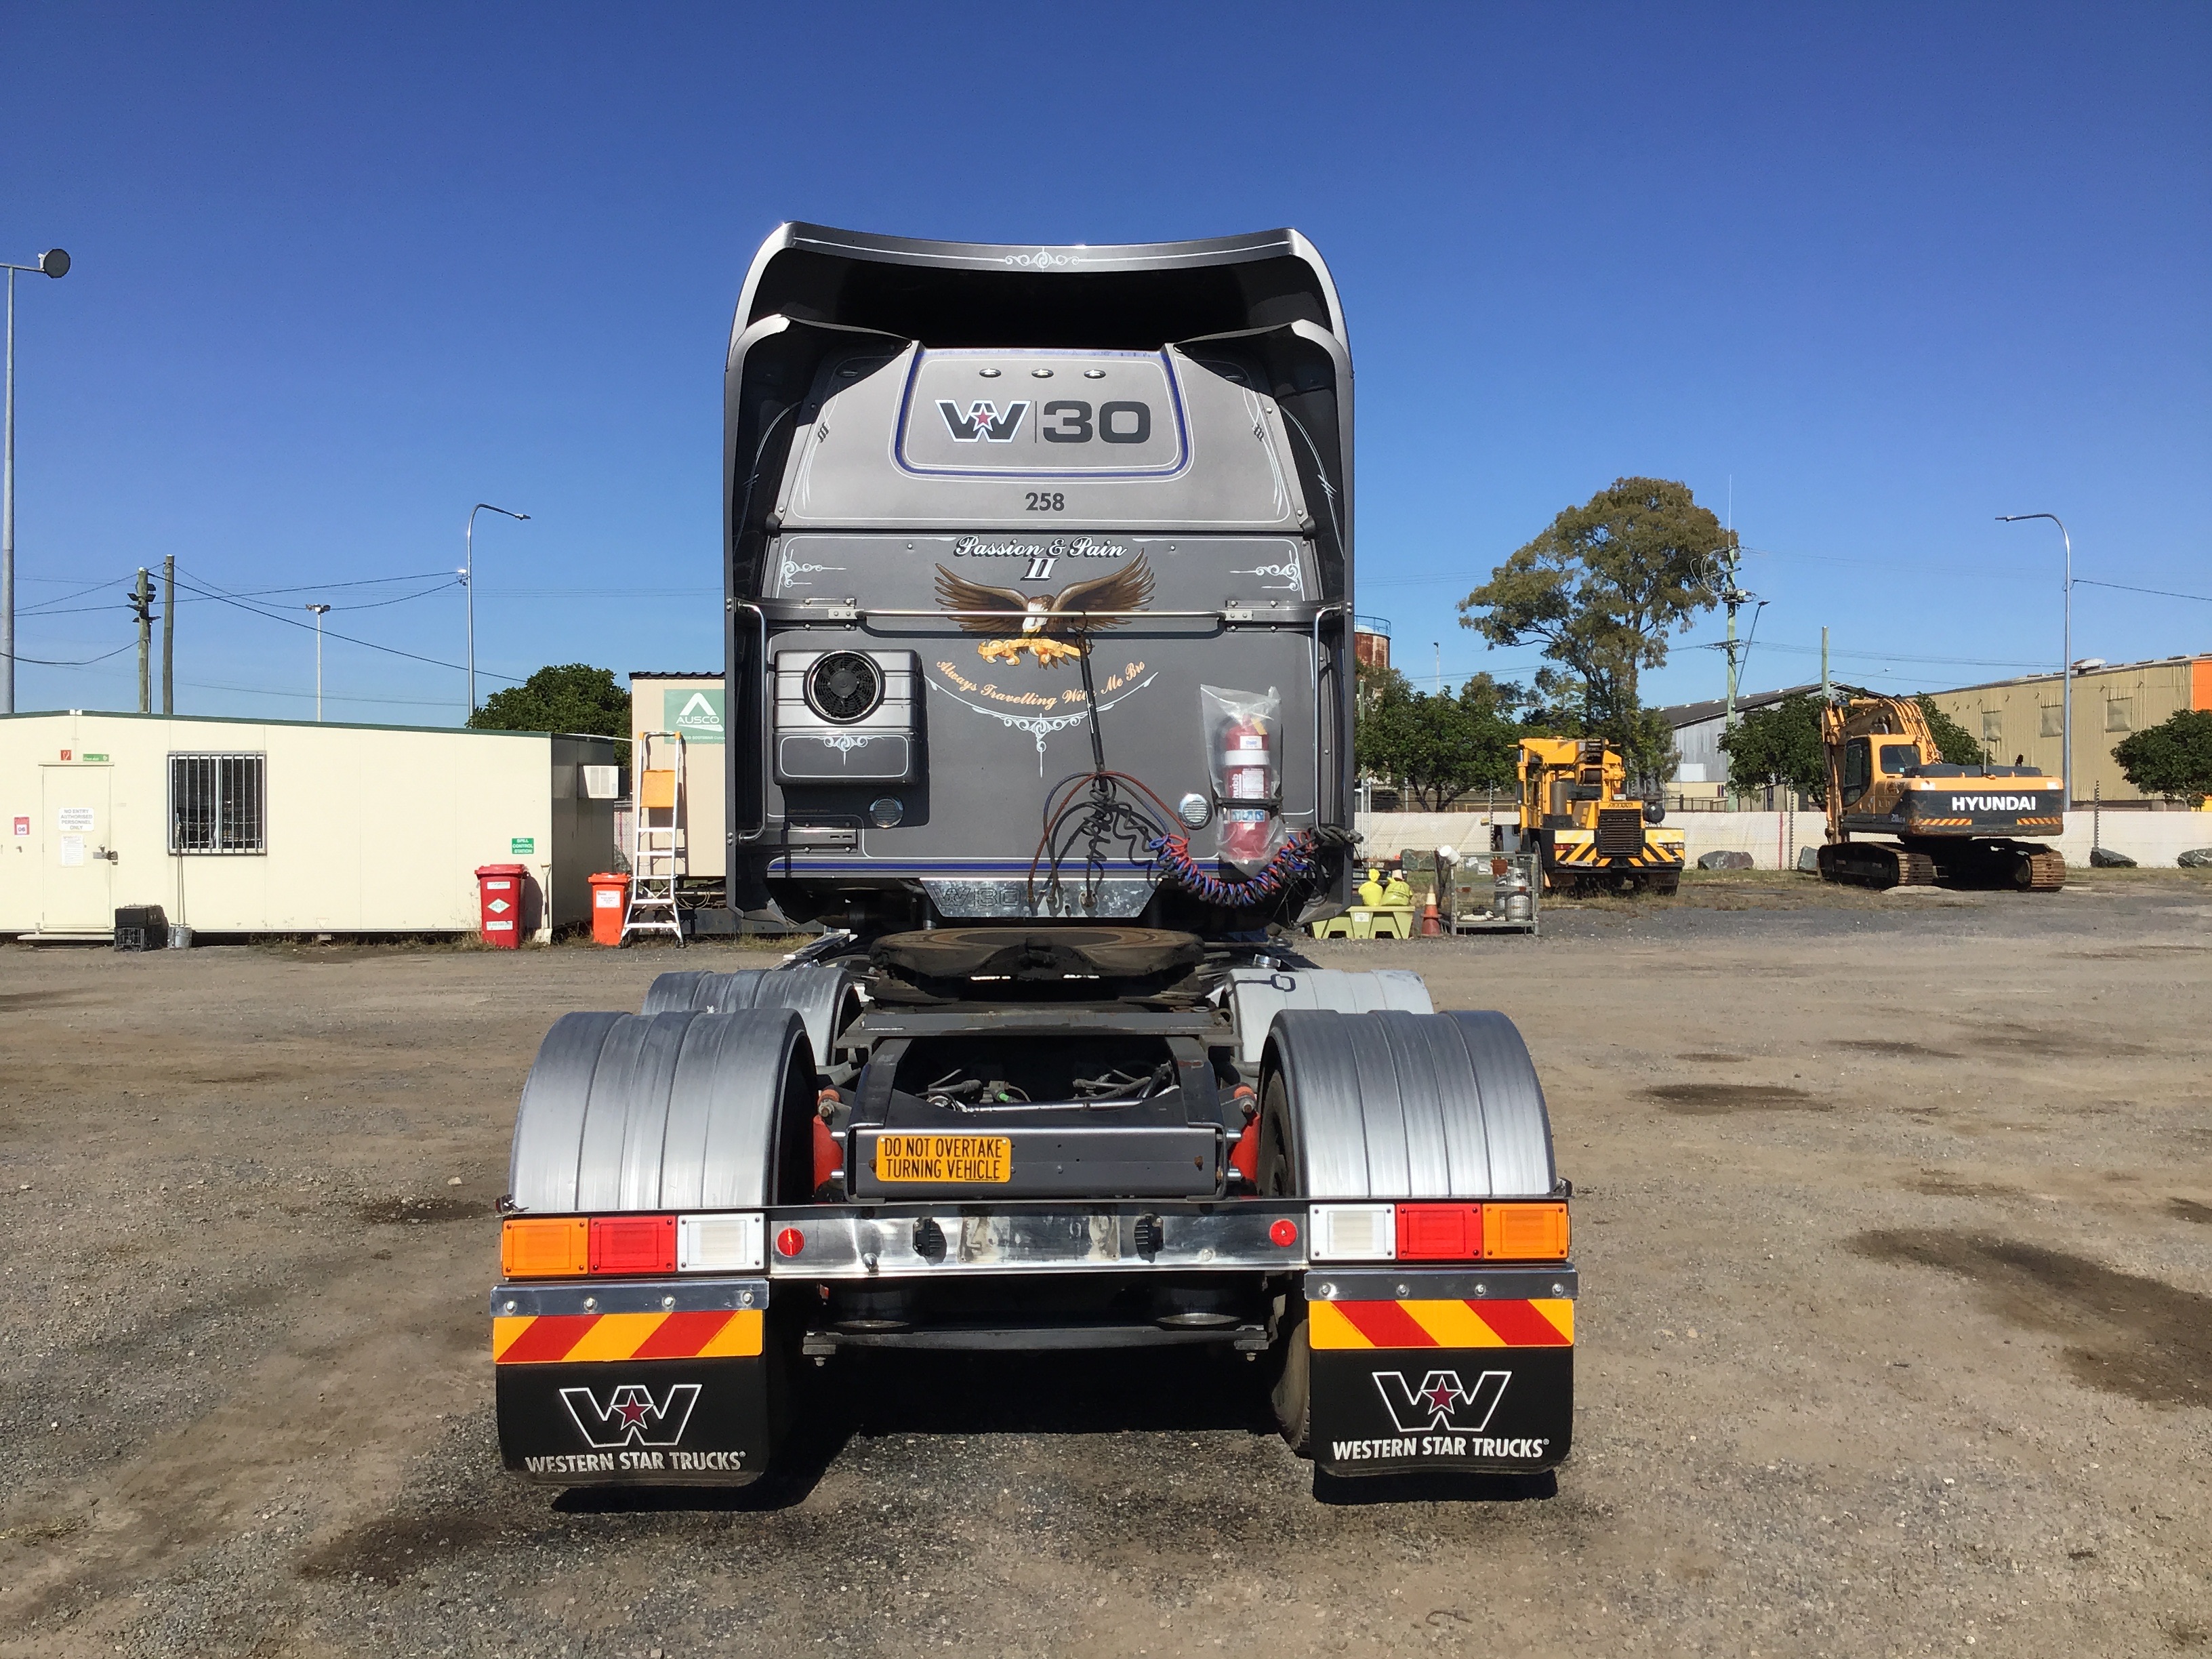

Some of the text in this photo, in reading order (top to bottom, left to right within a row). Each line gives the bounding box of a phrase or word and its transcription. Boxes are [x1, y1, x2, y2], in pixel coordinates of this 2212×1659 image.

[1043, 401, 1151, 444] 30
[1025, 493, 1065, 511] 258
[954, 535, 1128, 558] Passion & Pain
[937, 661, 978, 692] Always
[980, 683, 1058, 711] Travelling
[1101, 674, 1124, 695] Me
[1125, 661, 1145, 681] Bro
[676, 716, 720, 724] AUSCO
[1952, 796, 2036, 811] HYUNDAI
[885, 1137, 1002, 1158] DO NOT OVERTAKE
[886, 1159, 1001, 1179] TURNING VEHICLE
[1332, 1437, 1417, 1460] WESTERN
[1422, 1437, 1466, 1456] STAR
[525, 1453, 615, 1473] WESTERN
[619, 1452, 665, 1470] STAR
